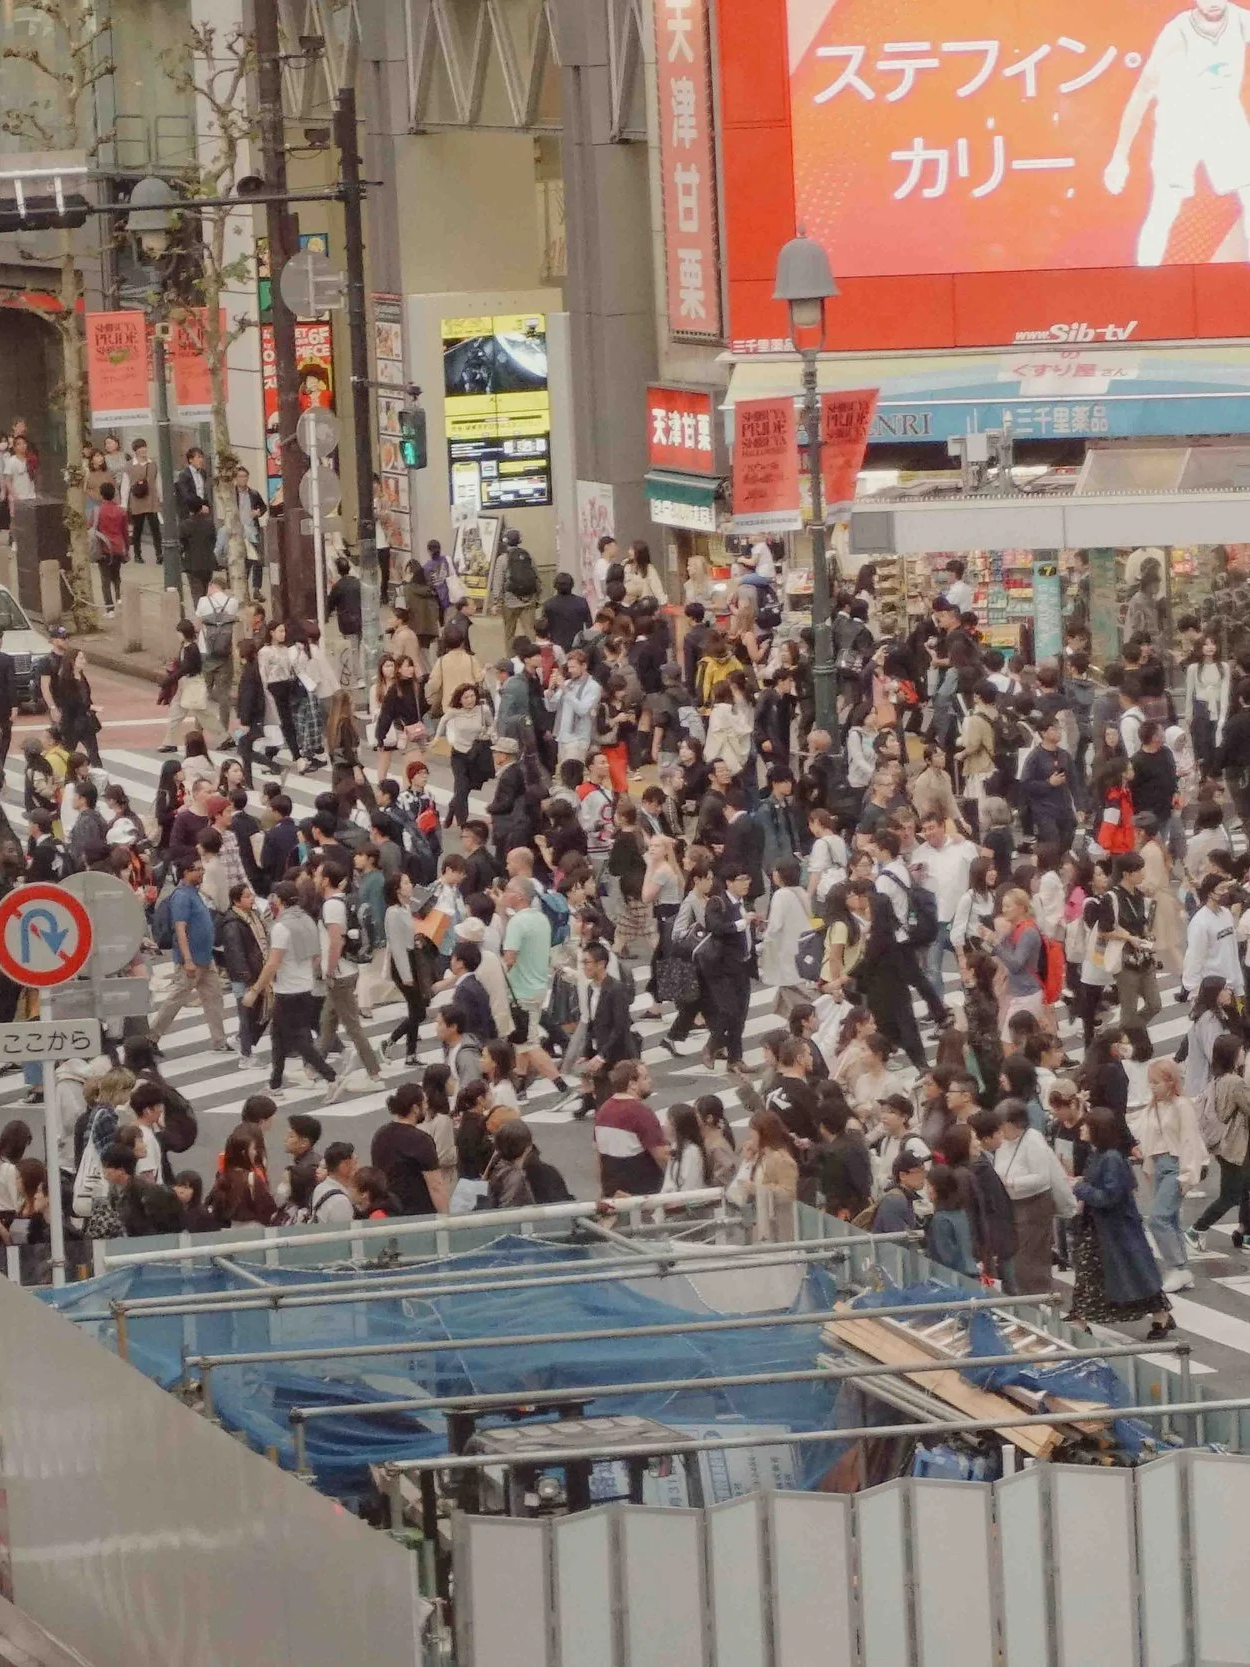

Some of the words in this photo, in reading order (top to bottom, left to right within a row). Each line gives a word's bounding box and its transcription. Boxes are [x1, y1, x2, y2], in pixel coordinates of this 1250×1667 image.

[664, 0, 707, 320] 天津甘栗
[890, 135, 1075, 200] カリー
[94, 332, 139, 346] PRIDE
[652, 408, 712, 451] 天津甘栗
[741, 421, 788, 437] PRIDE
[1014, 405, 1109, 435] 三千里薬品
[3, 1030, 91, 1053] ここから
